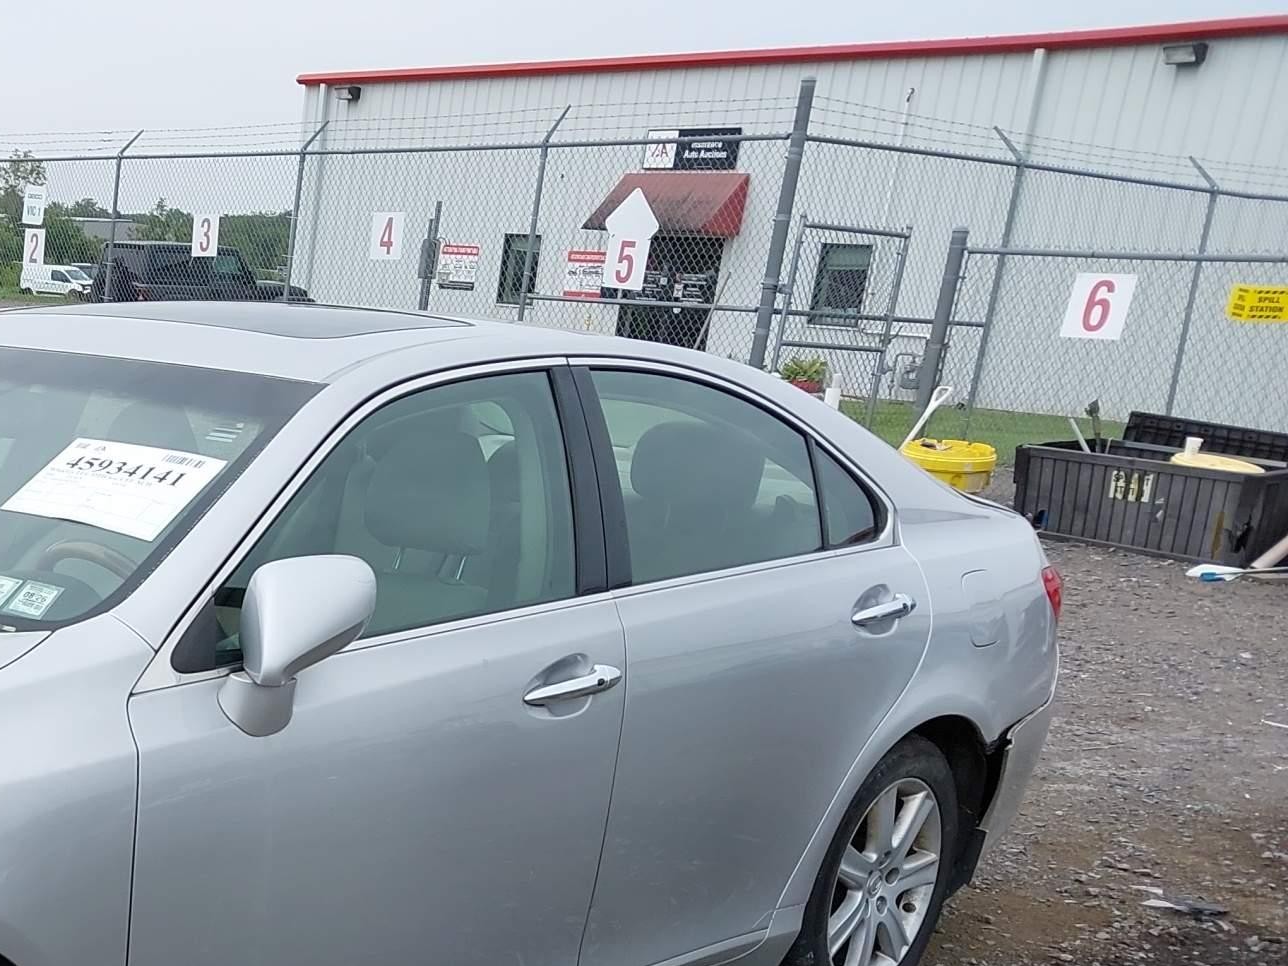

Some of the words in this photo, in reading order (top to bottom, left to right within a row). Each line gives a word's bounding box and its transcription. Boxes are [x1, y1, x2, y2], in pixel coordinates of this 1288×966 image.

[28, 233, 39, 264] 2
[199, 217, 211, 252] 3
[379, 216, 393, 255] 4
[615, 240, 637, 284] 5
[1082, 279, 1115, 332] 6
[1248, 305, 1284, 313] STATION
[66, 456, 187, 487] 45934141
